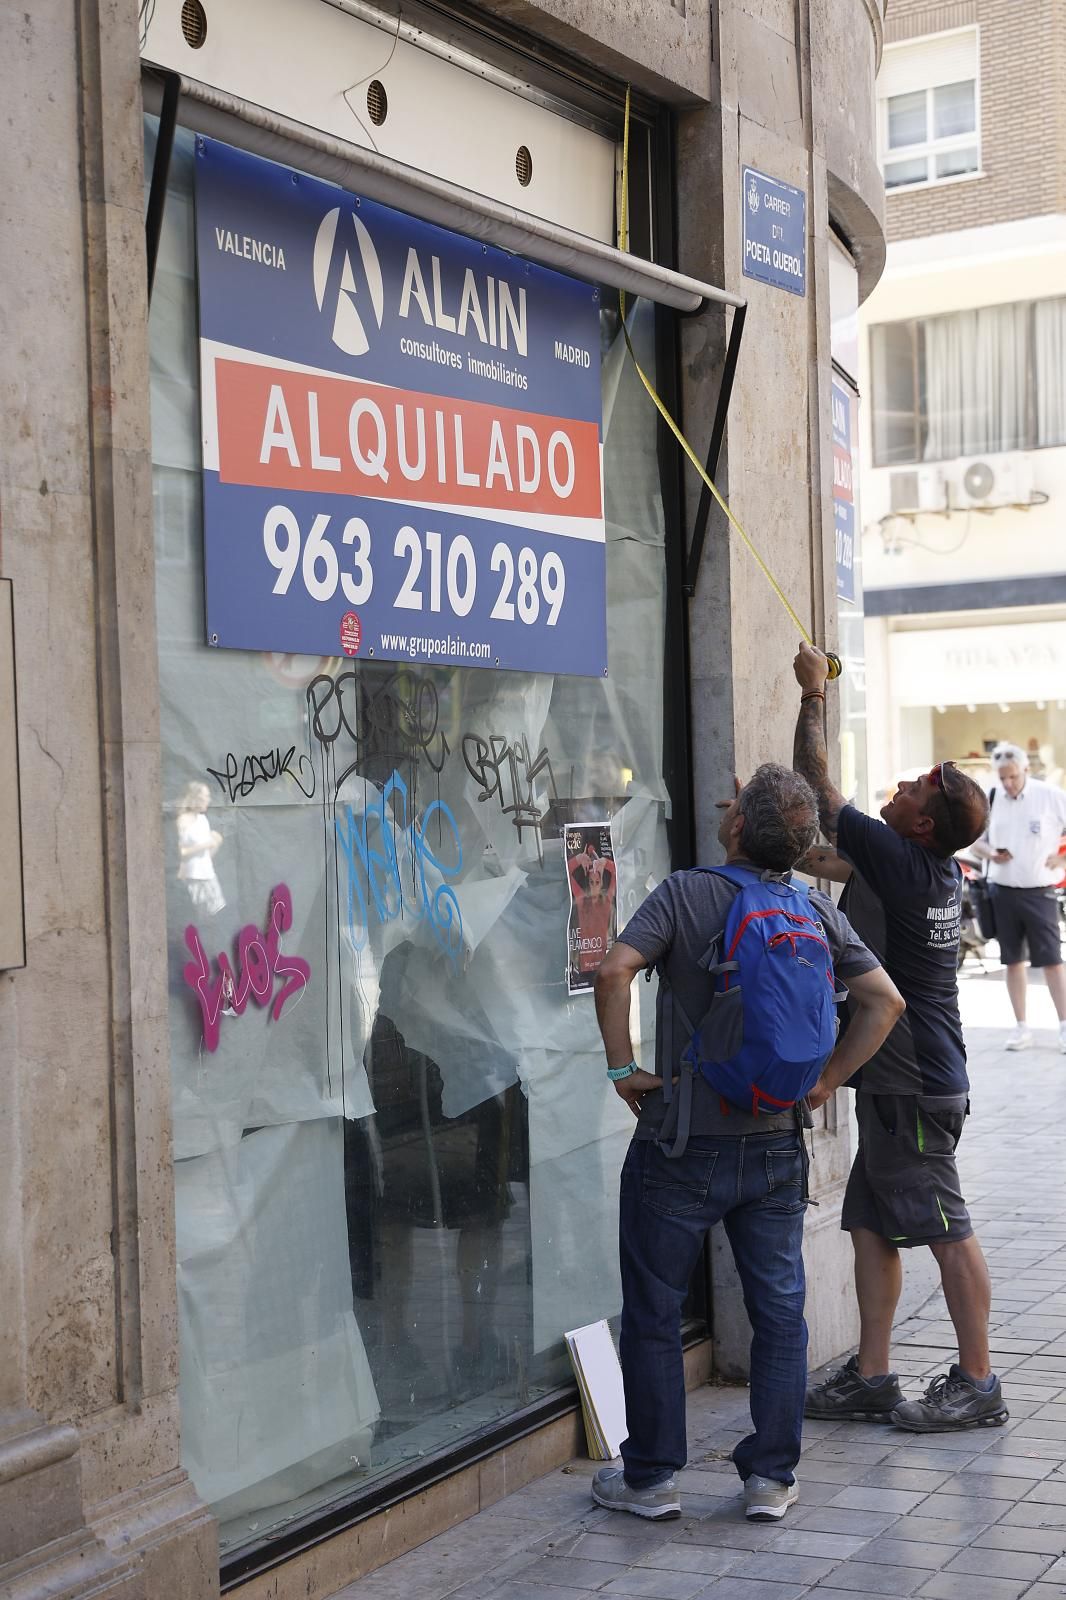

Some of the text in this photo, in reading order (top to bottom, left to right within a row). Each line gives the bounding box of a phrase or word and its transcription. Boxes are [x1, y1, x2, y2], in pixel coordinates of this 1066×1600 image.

[764, 194, 791, 217] CARRER
[215, 226, 286, 271] VALENCIA
[746, 240, 802, 277] POETA QUEROL
[399, 247, 528, 357] ALAIN
[400, 336, 529, 391] consultores inmobiliarios
[554, 340, 591, 369] MADRID
[259, 384, 576, 499] ALQUILADO
[263, 504, 566, 626] 963 210 289
[381, 634, 491, 659] www.grupoalain.com
[569, 927, 582, 940] LIVE
[569, 936, 603, 951] FLAMENCO
